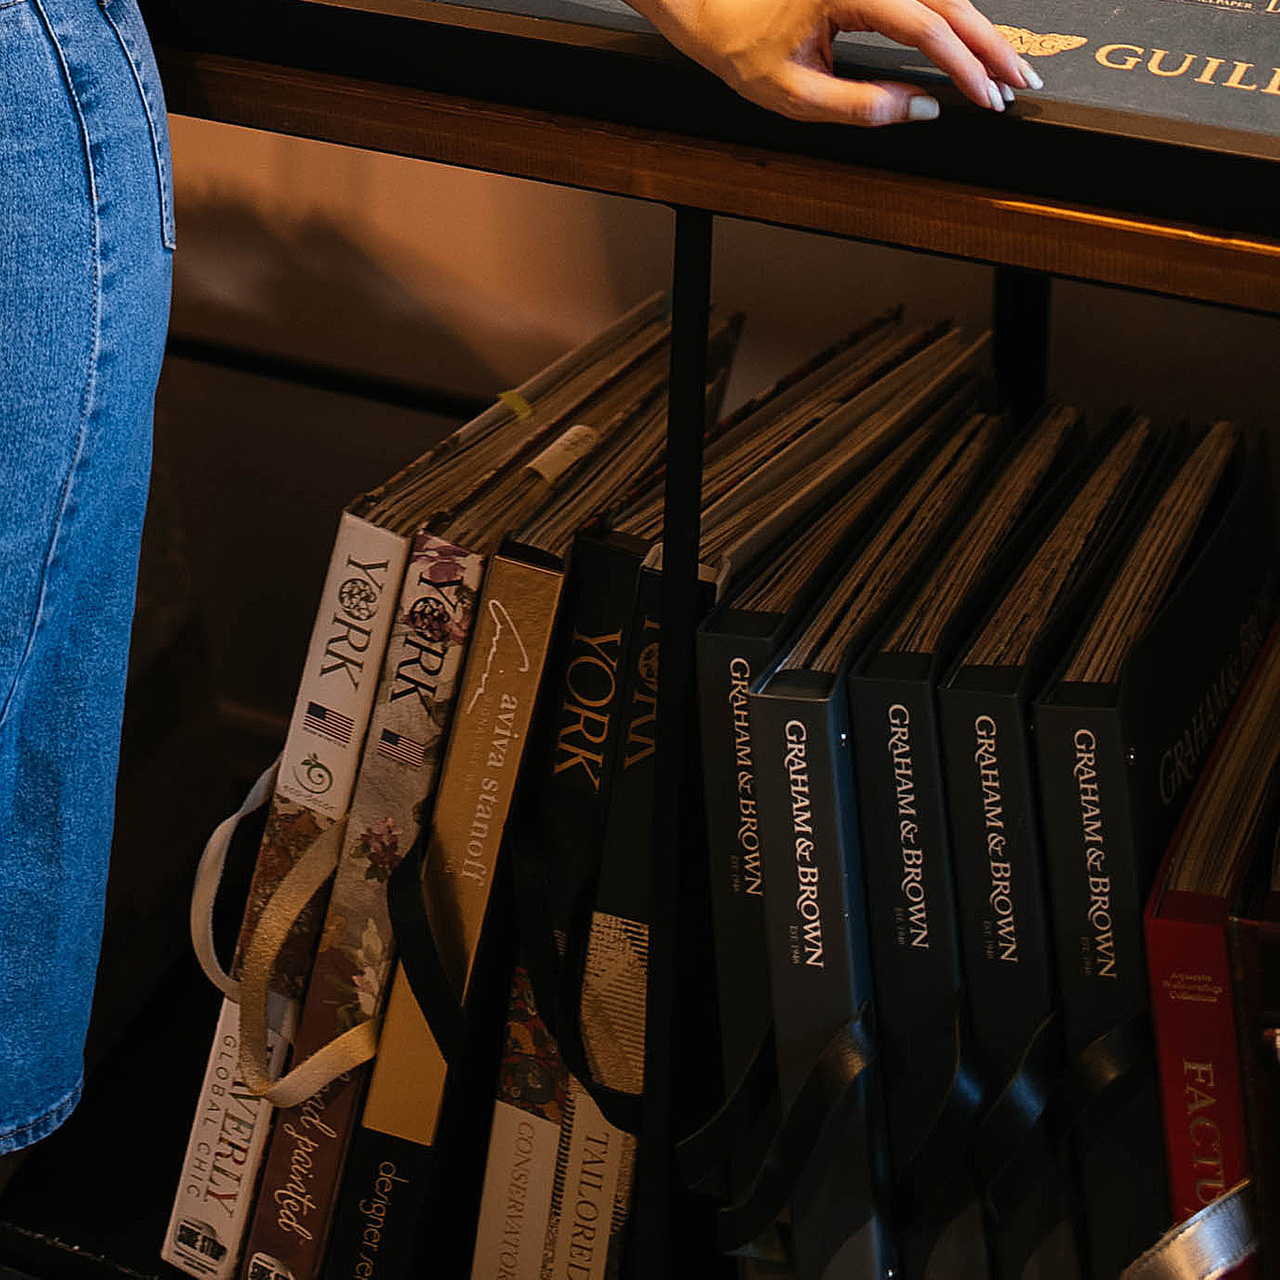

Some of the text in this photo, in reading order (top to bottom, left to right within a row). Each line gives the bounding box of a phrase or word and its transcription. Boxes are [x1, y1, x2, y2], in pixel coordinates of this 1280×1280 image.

[320, 554, 389, 691] YORK
[391, 571, 464, 717] YORK
[487, 693, 519, 768] aviva
[552, 623, 624, 795] YORK
[461, 778, 500, 887] stanoff
[729, 657, 764, 898] GRAHAM & BROWN
[887, 703, 931, 950] GRAHAM & BROWN
[1073, 728, 1103, 844] GRAHAM
[784, 719, 825, 969] GRAHAM & BROWN
[974, 714, 1019, 964] GRAHAM & BROWN
[1086, 847, 1106, 872] &
[1087, 876, 1118, 981] BROWN
[201, 1034, 238, 1127] GLOBAL
[1183, 1055, 1227, 1213] FACTU
[185, 1141, 211, 1199] CHIC
[273, 1122, 319, 1241] painted
[358, 1159, 410, 1253] designer
